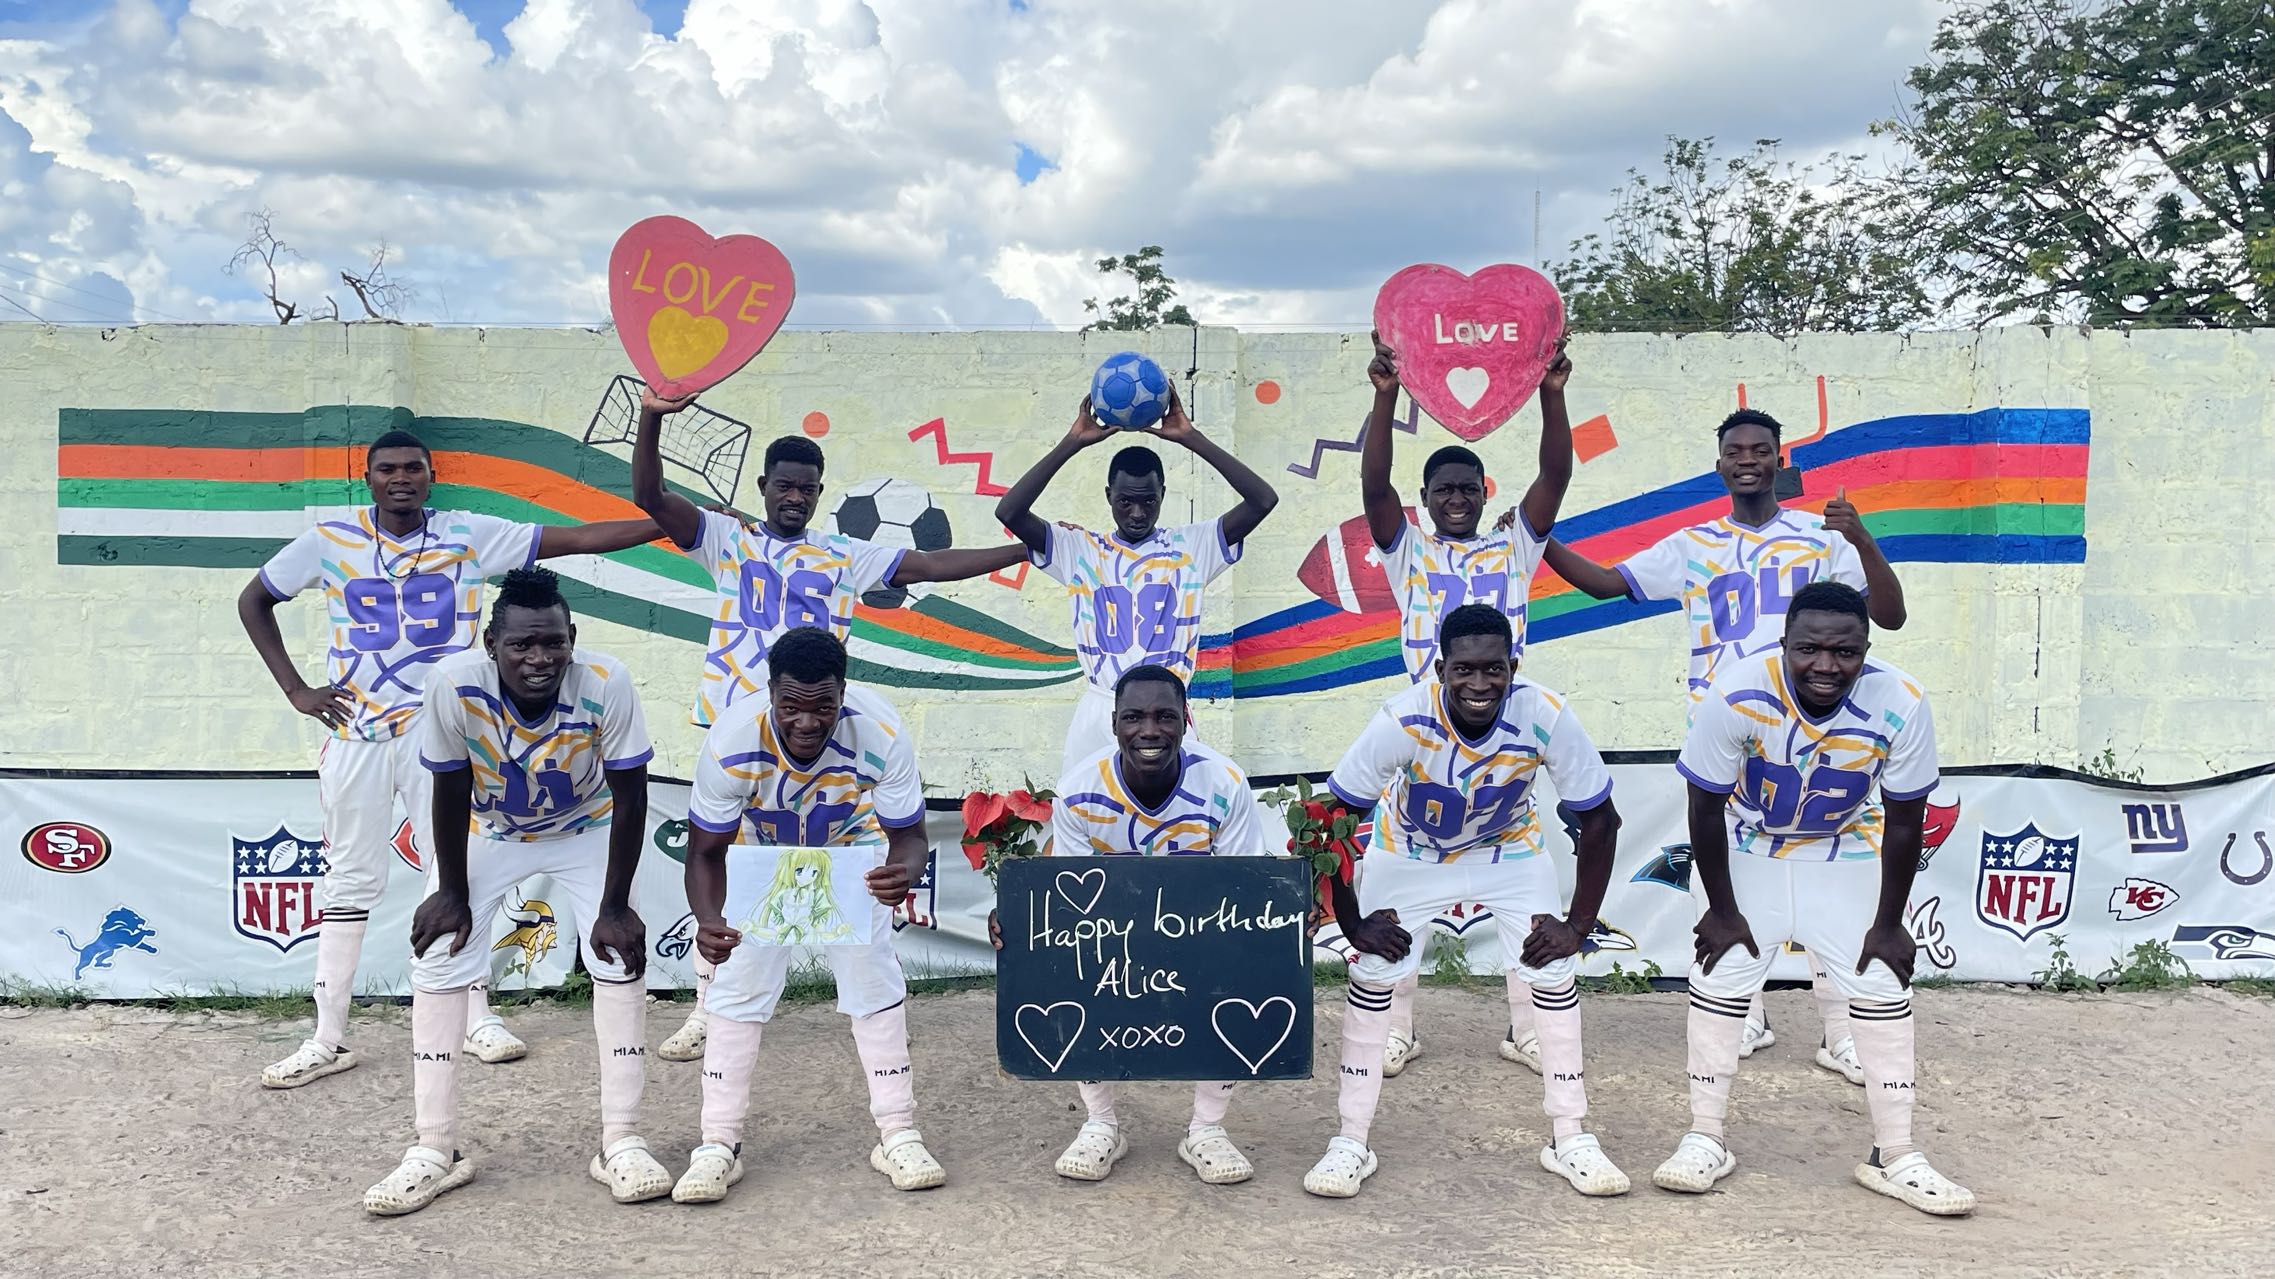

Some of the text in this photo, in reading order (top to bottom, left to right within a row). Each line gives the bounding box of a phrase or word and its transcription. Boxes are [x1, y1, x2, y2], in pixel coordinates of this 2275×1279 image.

[631, 248, 776, 325] LOVE
[1434, 313, 1519, 345] LOVE
[344, 573, 457, 652] 99
[739, 560, 834, 633] 06
[1093, 582, 1178, 655] 08
[1408, 778, 1531, 840] 07
[1746, 756, 1872, 832] 02
[242, 881, 323, 937] NFL
[1026, 889, 1134, 981] Happy
[1153, 886, 1306, 967] birthday
[1984, 874, 2063, 926] NFL
